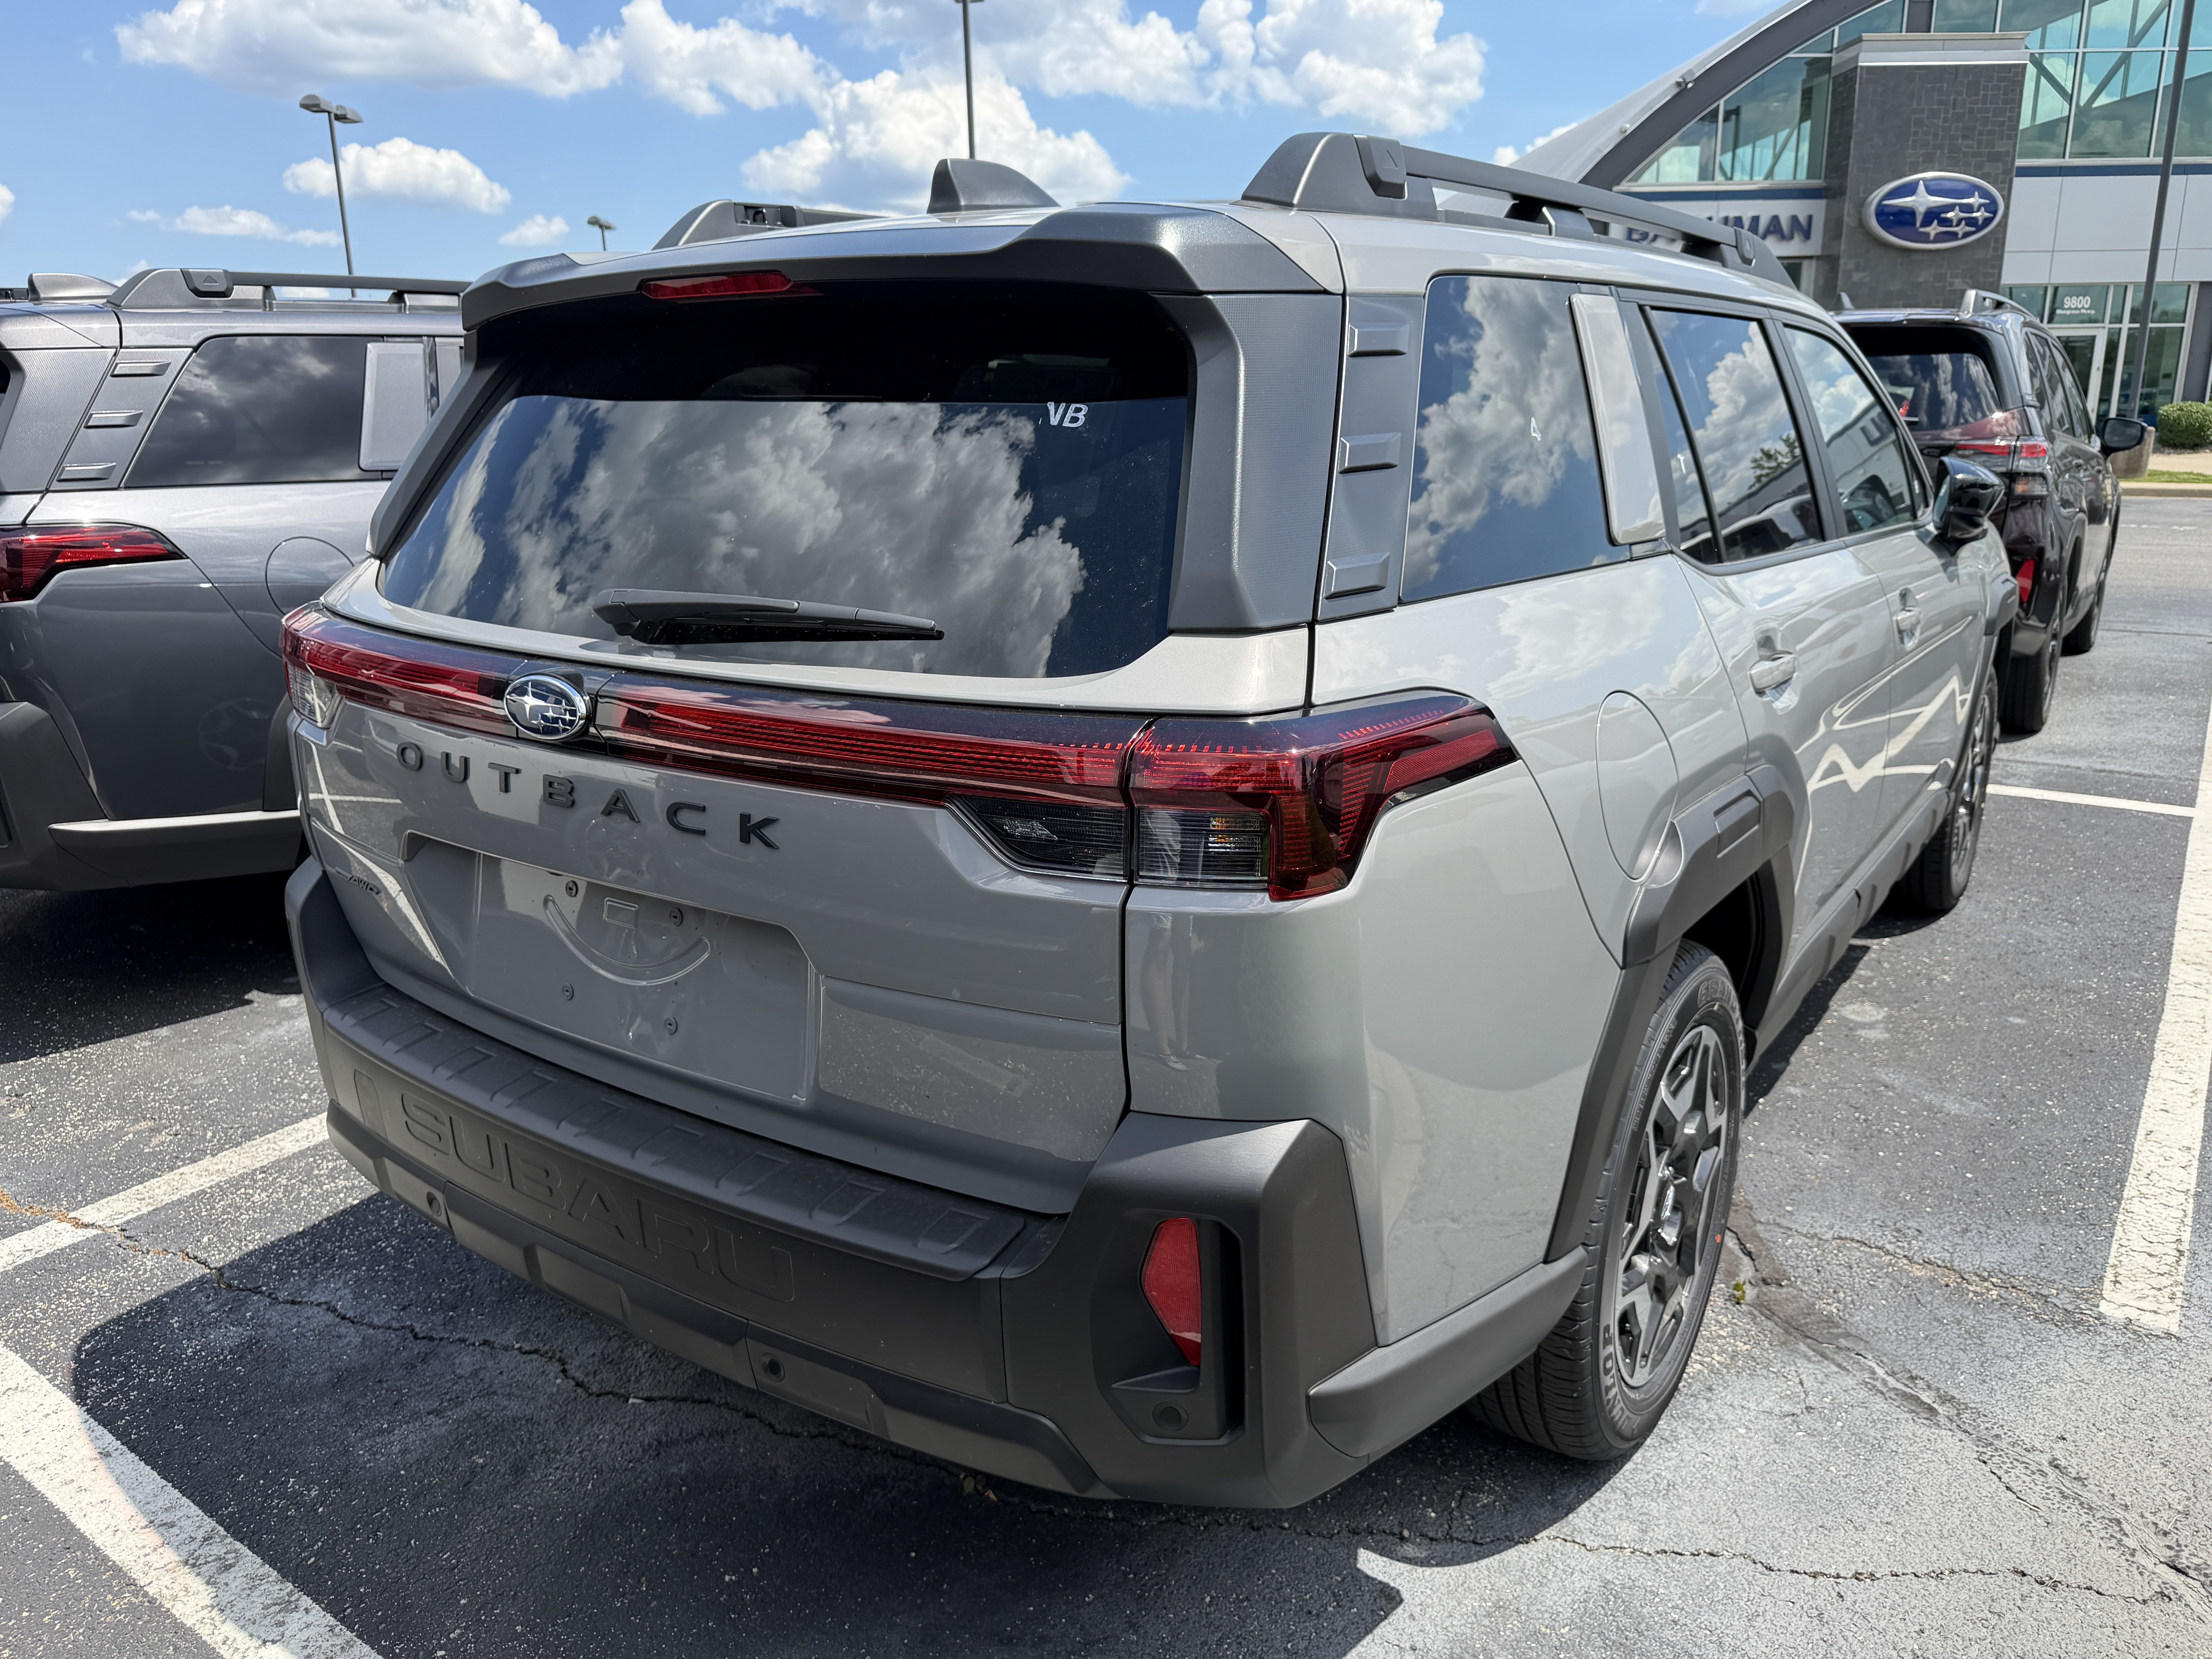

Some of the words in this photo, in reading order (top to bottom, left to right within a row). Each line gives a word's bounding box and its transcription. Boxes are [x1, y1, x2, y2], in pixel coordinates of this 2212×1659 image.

[2064, 295, 2091, 308] 9800
[1047, 402, 1088, 427] VB
[396, 741, 780, 849] OUTBACK
[401, 1092, 795, 1302] SUBARU
